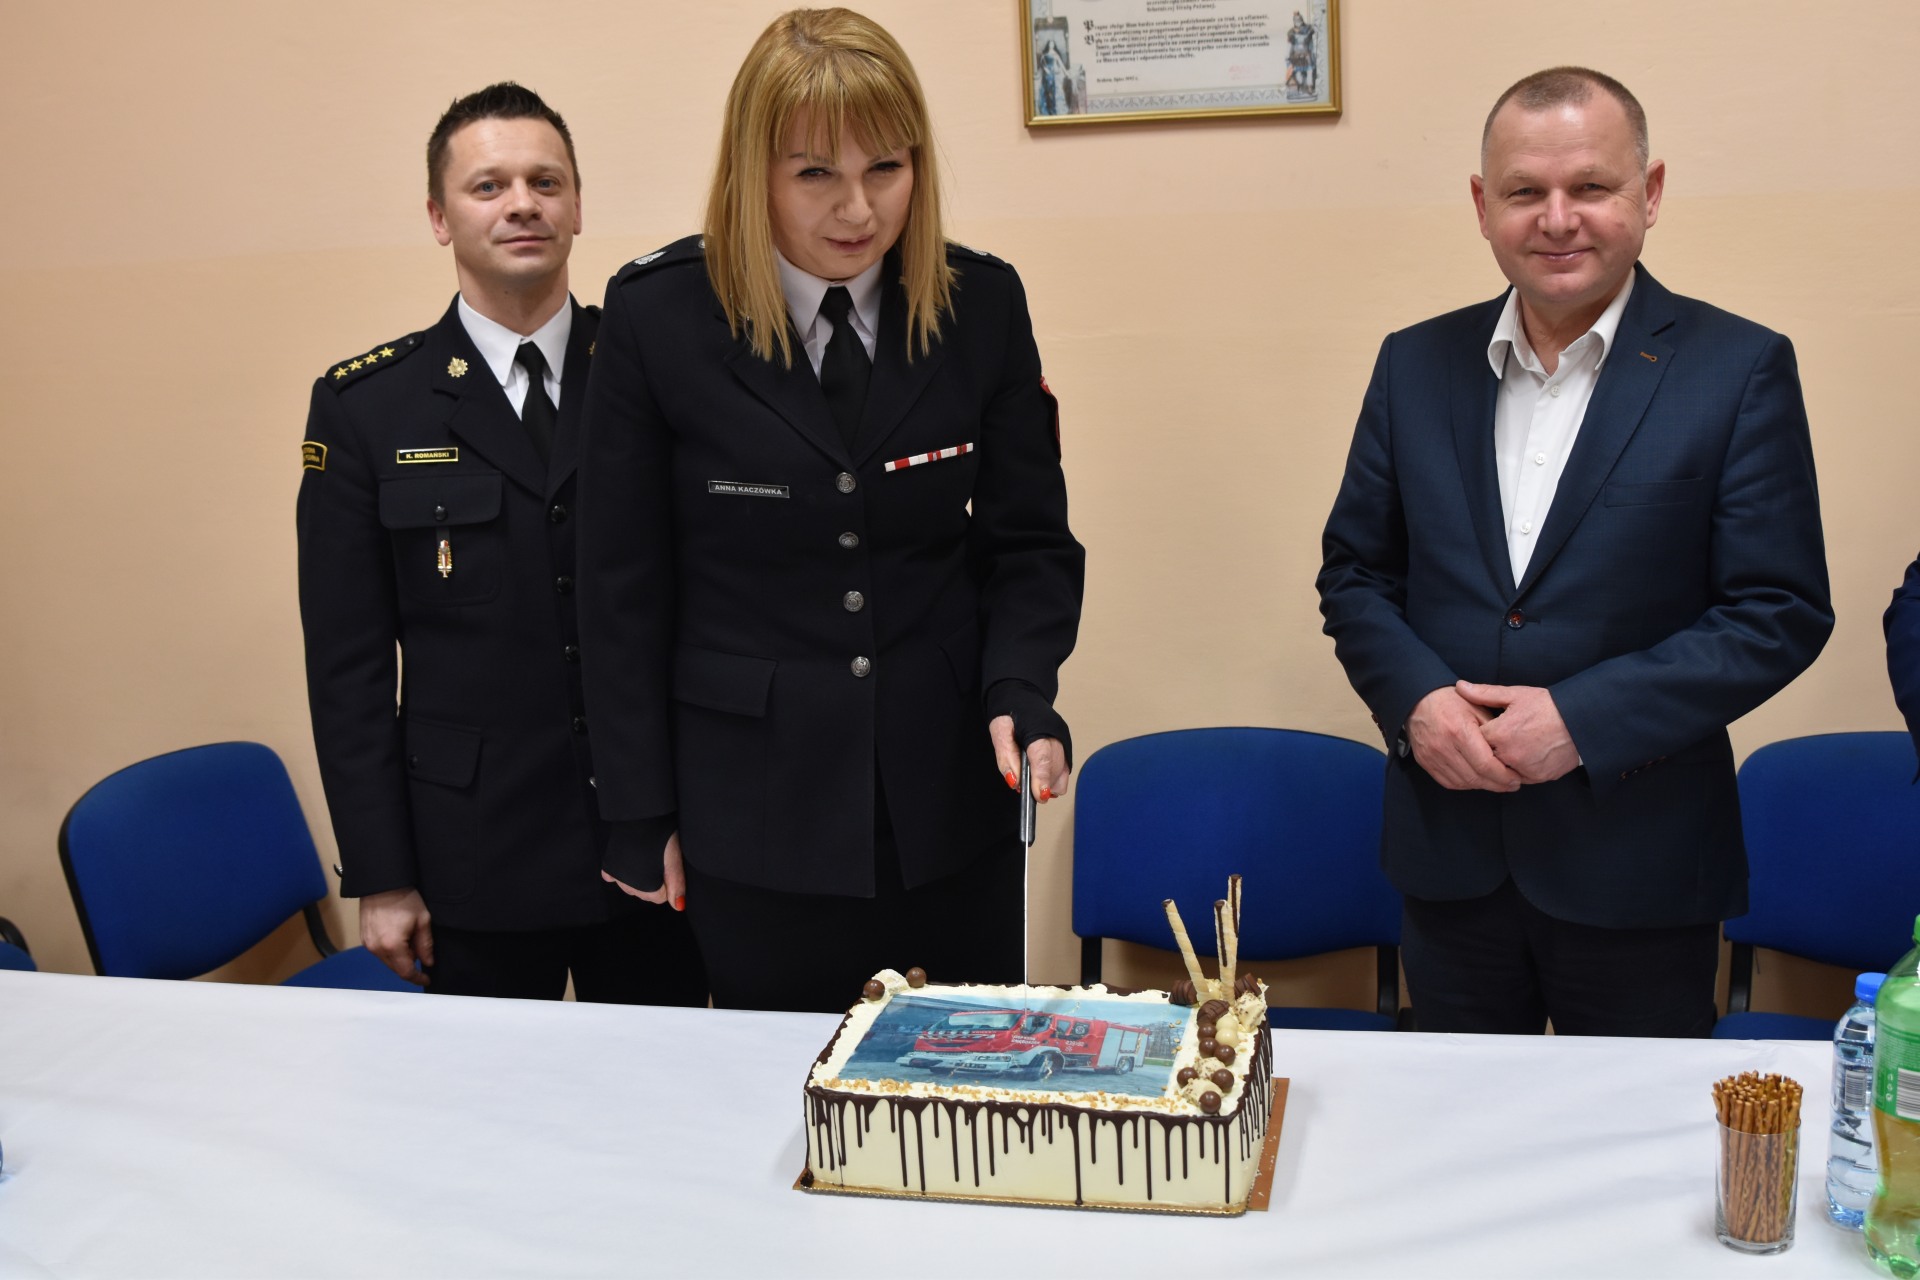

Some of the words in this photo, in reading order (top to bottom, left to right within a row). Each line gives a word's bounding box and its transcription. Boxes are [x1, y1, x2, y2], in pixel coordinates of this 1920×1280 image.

[414, 451, 449, 459] ROMAŃSKI
[714, 484, 737, 492] ANNA
[738, 486, 783, 495] KACZÓWKA
